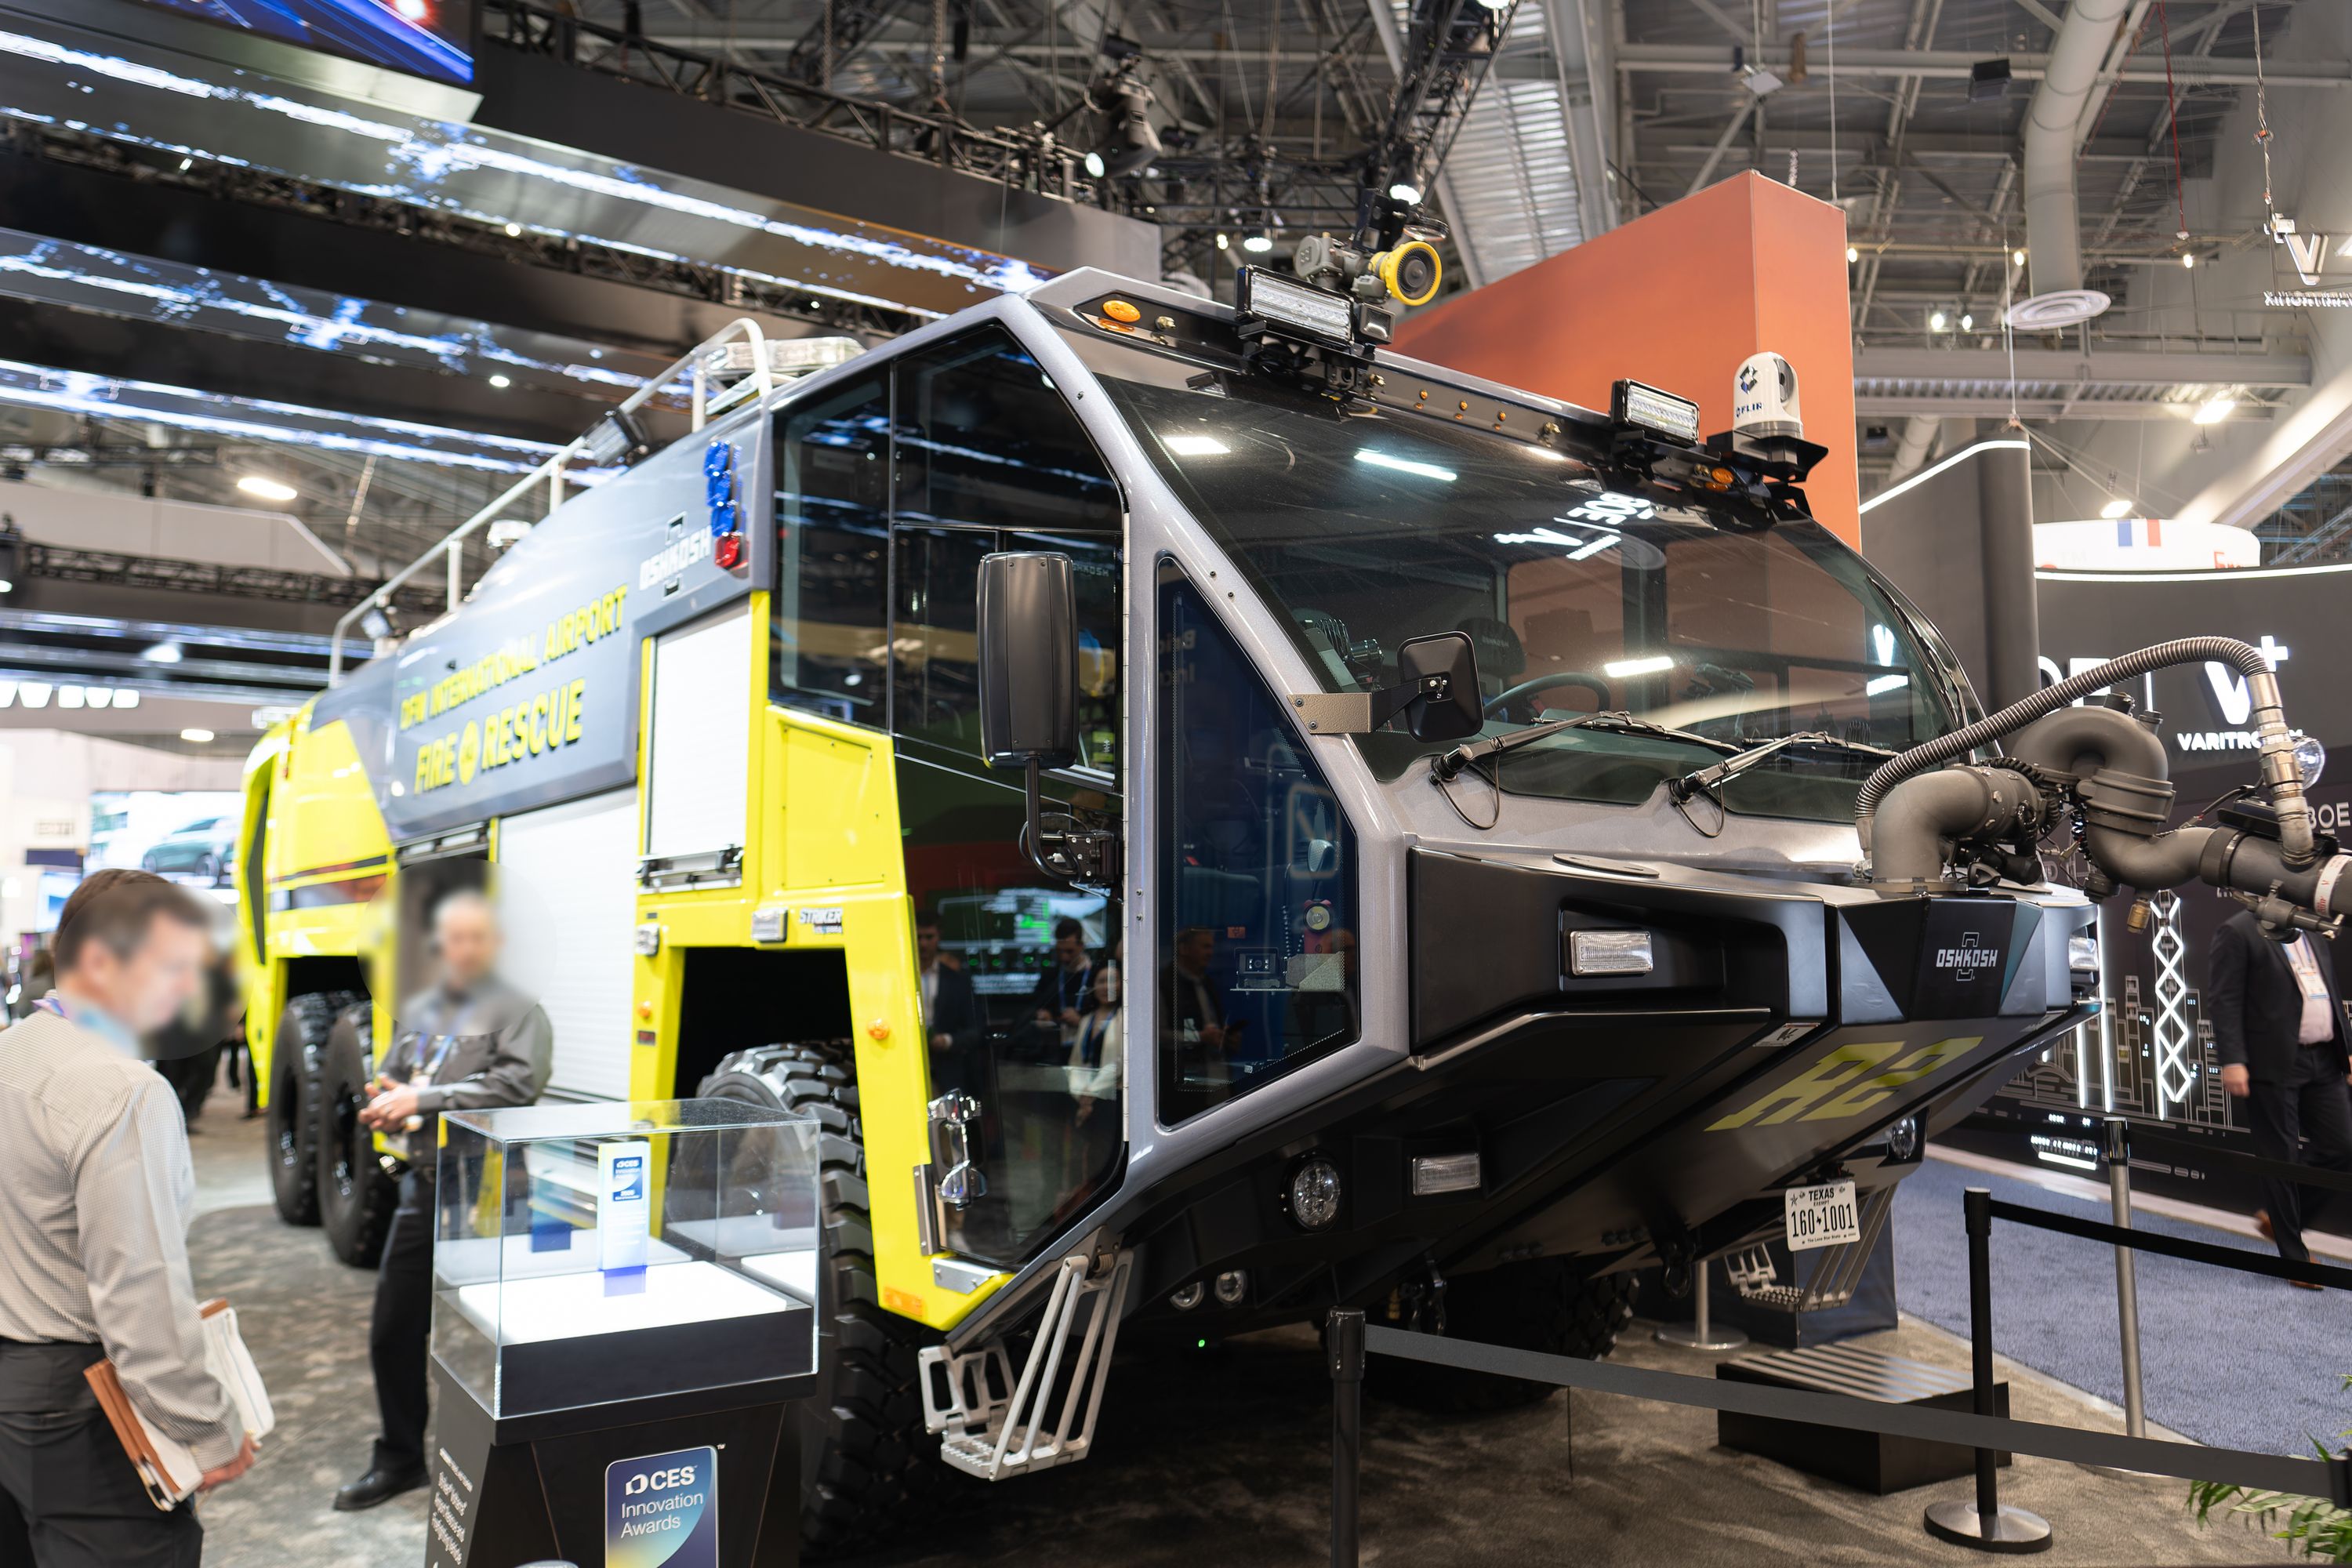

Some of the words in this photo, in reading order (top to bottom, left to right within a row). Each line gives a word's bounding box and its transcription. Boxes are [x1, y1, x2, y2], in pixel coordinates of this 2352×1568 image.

[639, 524, 712, 591] OSHKOSH
[1073, 563, 1109, 577] SHKOSH
[543, 583, 628, 665] AIRPORT
[413, 731, 459, 795] FIRE
[481, 677, 586, 771] RESCUE
[798, 906, 844, 924] STRIKER
[1936, 949, 1998, 967] OSHKOSH
[1702, 1036, 1985, 1132] R2
[1809, 1187, 1835, 1201] TEXAS
[649, 1466, 697, 1491] CES
[621, 1492, 704, 1519] Innovation
[620, 1514, 681, 1539] Awards
